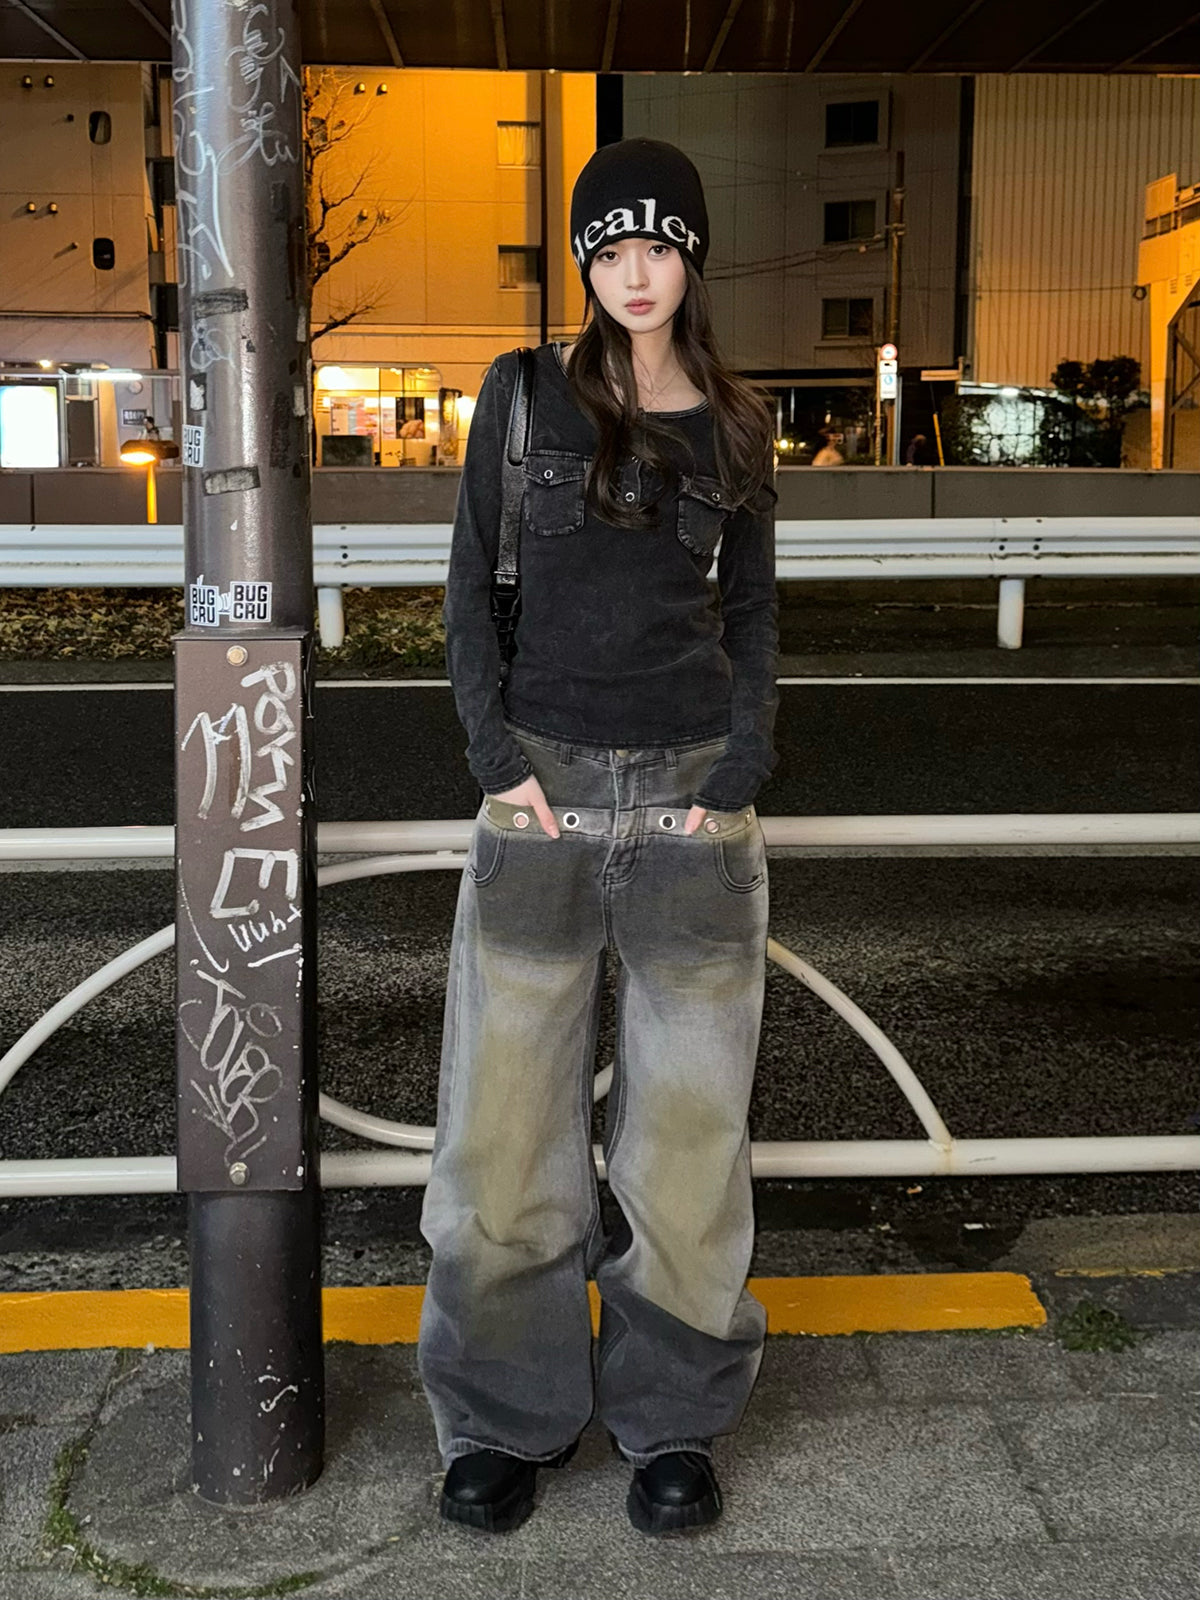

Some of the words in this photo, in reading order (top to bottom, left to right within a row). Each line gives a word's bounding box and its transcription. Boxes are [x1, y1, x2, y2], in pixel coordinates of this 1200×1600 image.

[192, 587, 215, 606] BUG
[233, 584, 268, 602] BUG
[192, 605, 215, 624] CRU
[233, 602, 267, 620] CRU
